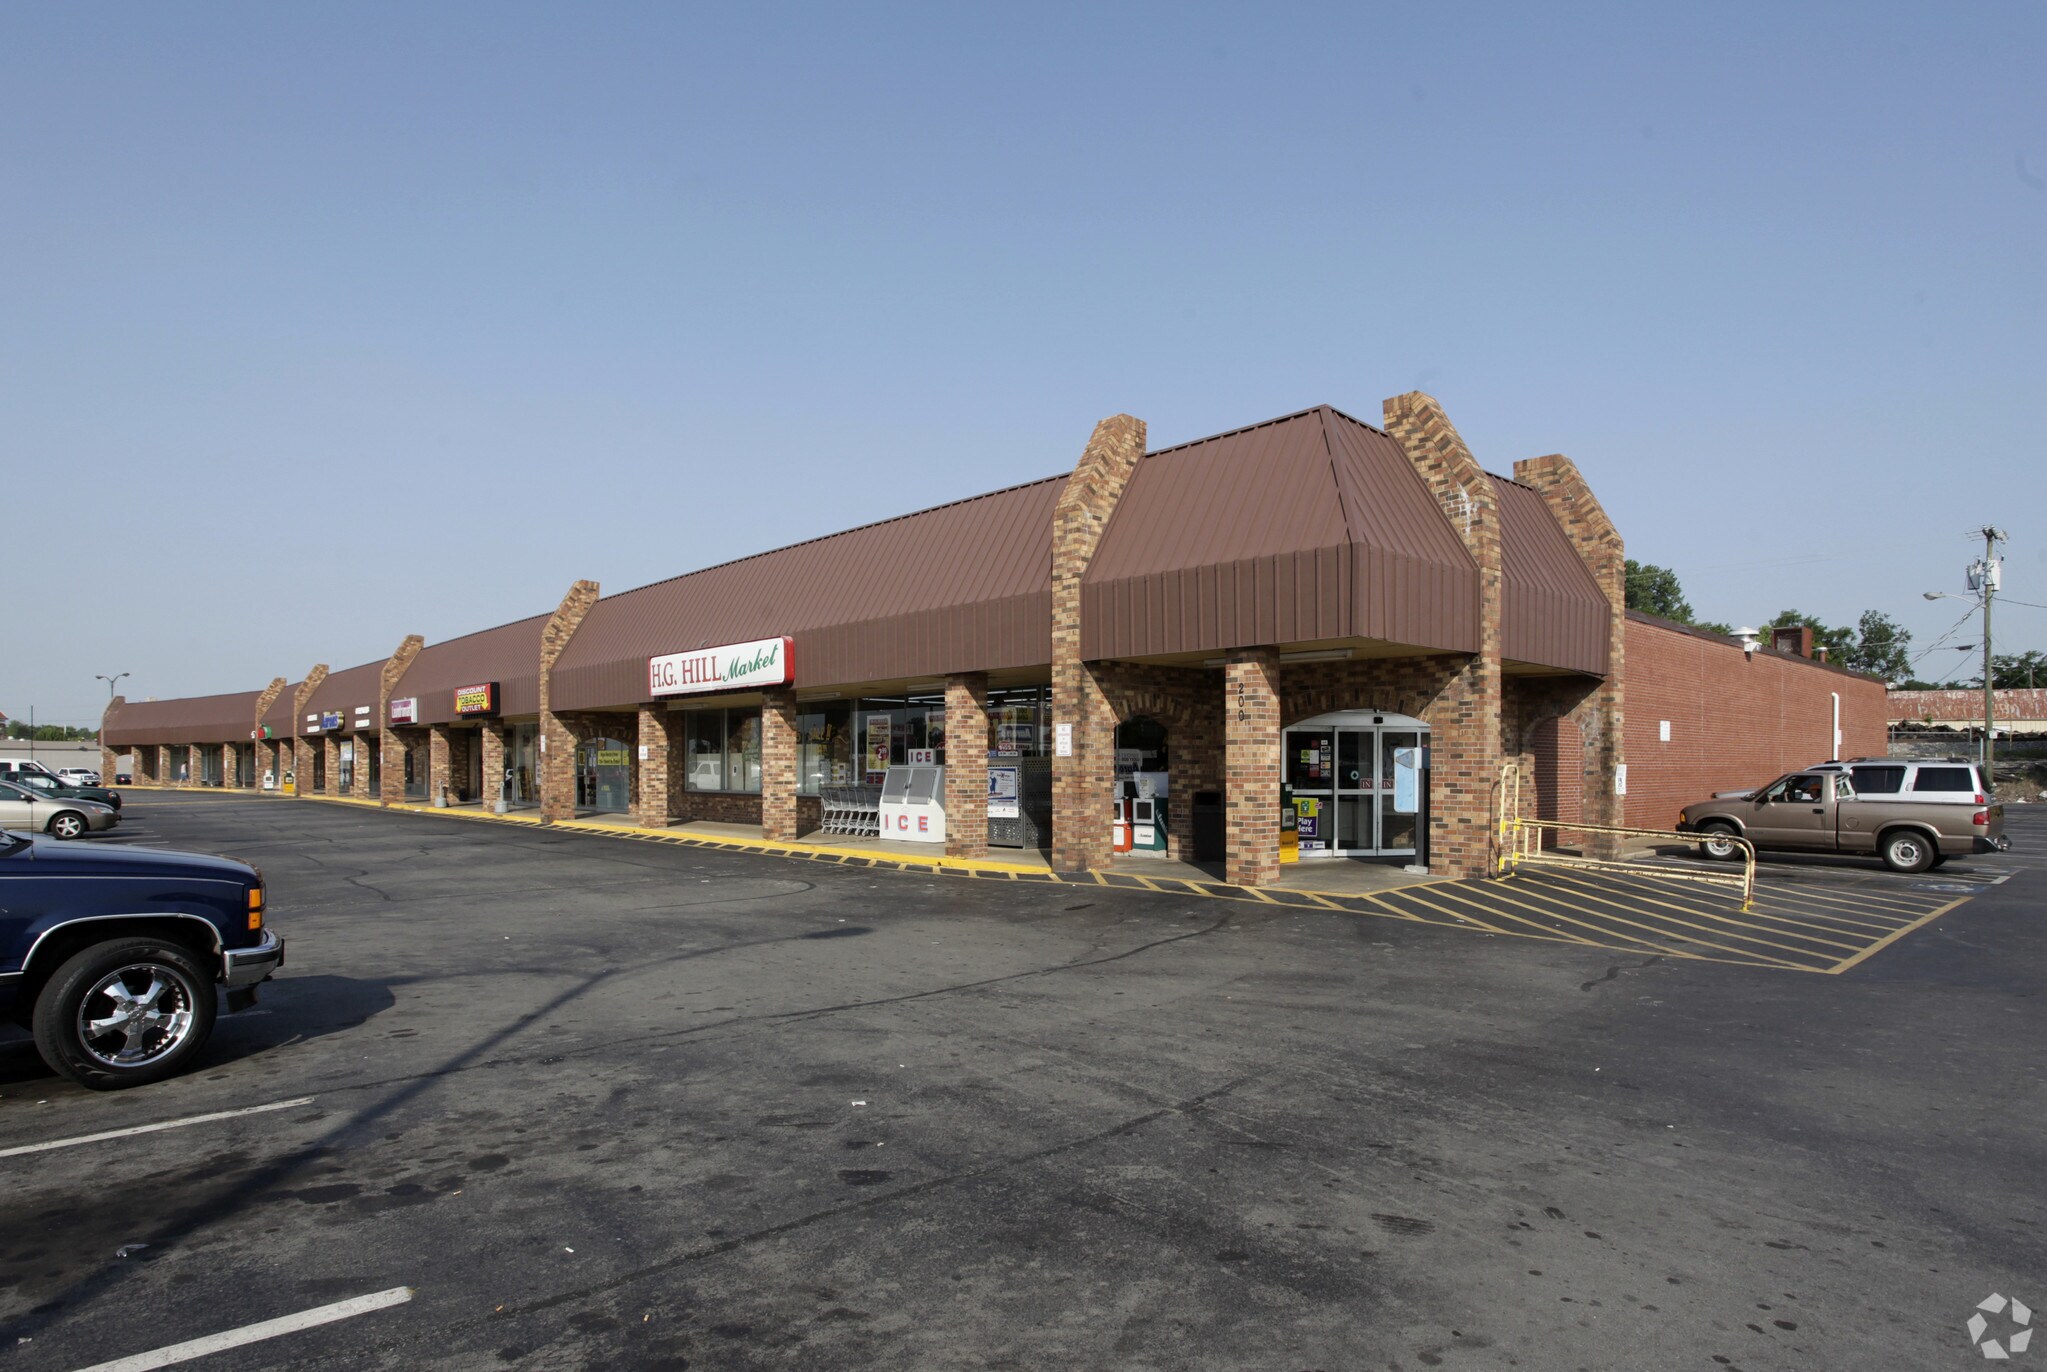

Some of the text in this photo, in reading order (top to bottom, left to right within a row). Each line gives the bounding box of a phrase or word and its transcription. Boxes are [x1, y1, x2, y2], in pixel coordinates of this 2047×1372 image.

[652, 644, 778, 688] H.G. HILL Market
[457, 686, 486, 696] DISCOUNT
[458, 694, 485, 705] TOBACCO
[462, 704, 481, 712] OUTLET
[911, 751, 932, 763] ICE
[884, 814, 929, 833] ICE
[1297, 817, 1313, 827] Play
